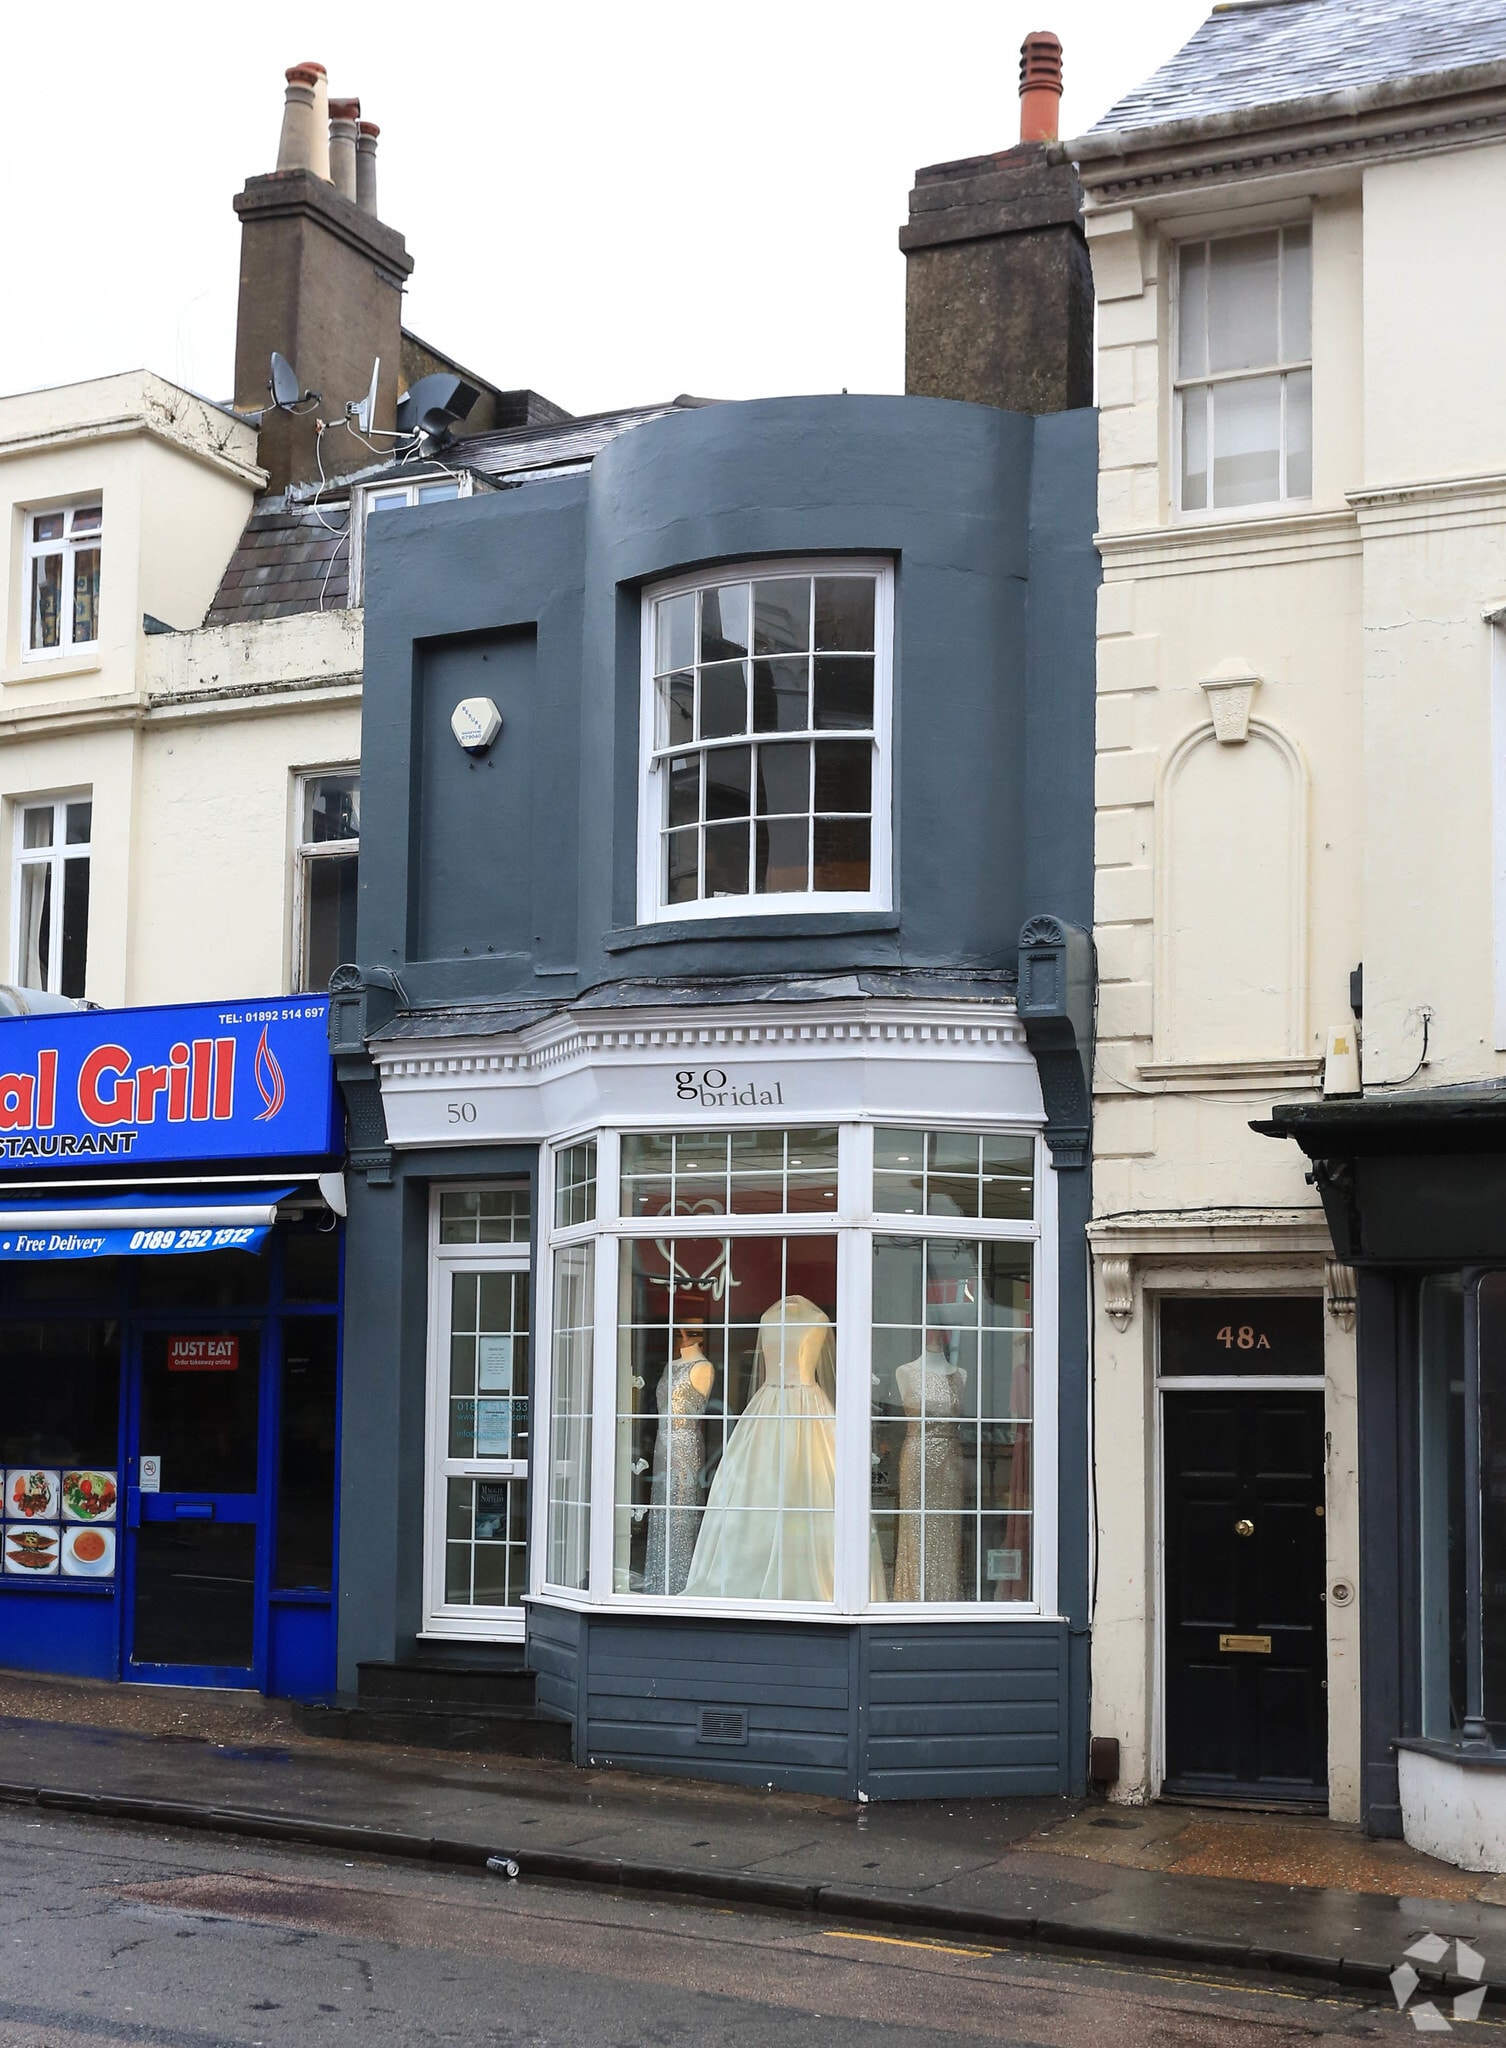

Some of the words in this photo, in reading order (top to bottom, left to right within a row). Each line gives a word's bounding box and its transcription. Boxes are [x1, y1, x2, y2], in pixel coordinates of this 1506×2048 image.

[219, 1013, 243, 1024] TEL:
[245, 1010, 278, 1023] 01892
[282, 1008, 301, 1020] 514
[304, 1007, 325, 1019] 697
[77, 1036, 237, 1127] Grill
[675, 1068, 727, 1100] go
[697, 1082, 785, 1107] bridal
[447, 1102, 478, 1124] 50
[15, 1235, 46, 1252] Free
[47, 1234, 106, 1253] Delivery
[129, 1230, 176, 1249] 0189
[174, 1229, 212, 1249] 252
[211, 1228, 254, 1246] 1312
[171, 1341, 205, 1356] JUST
[207, 1341, 234, 1356] EAT
[1216, 1325, 1271, 1349] 48A
[189, 1359, 214, 1367] takeaway
